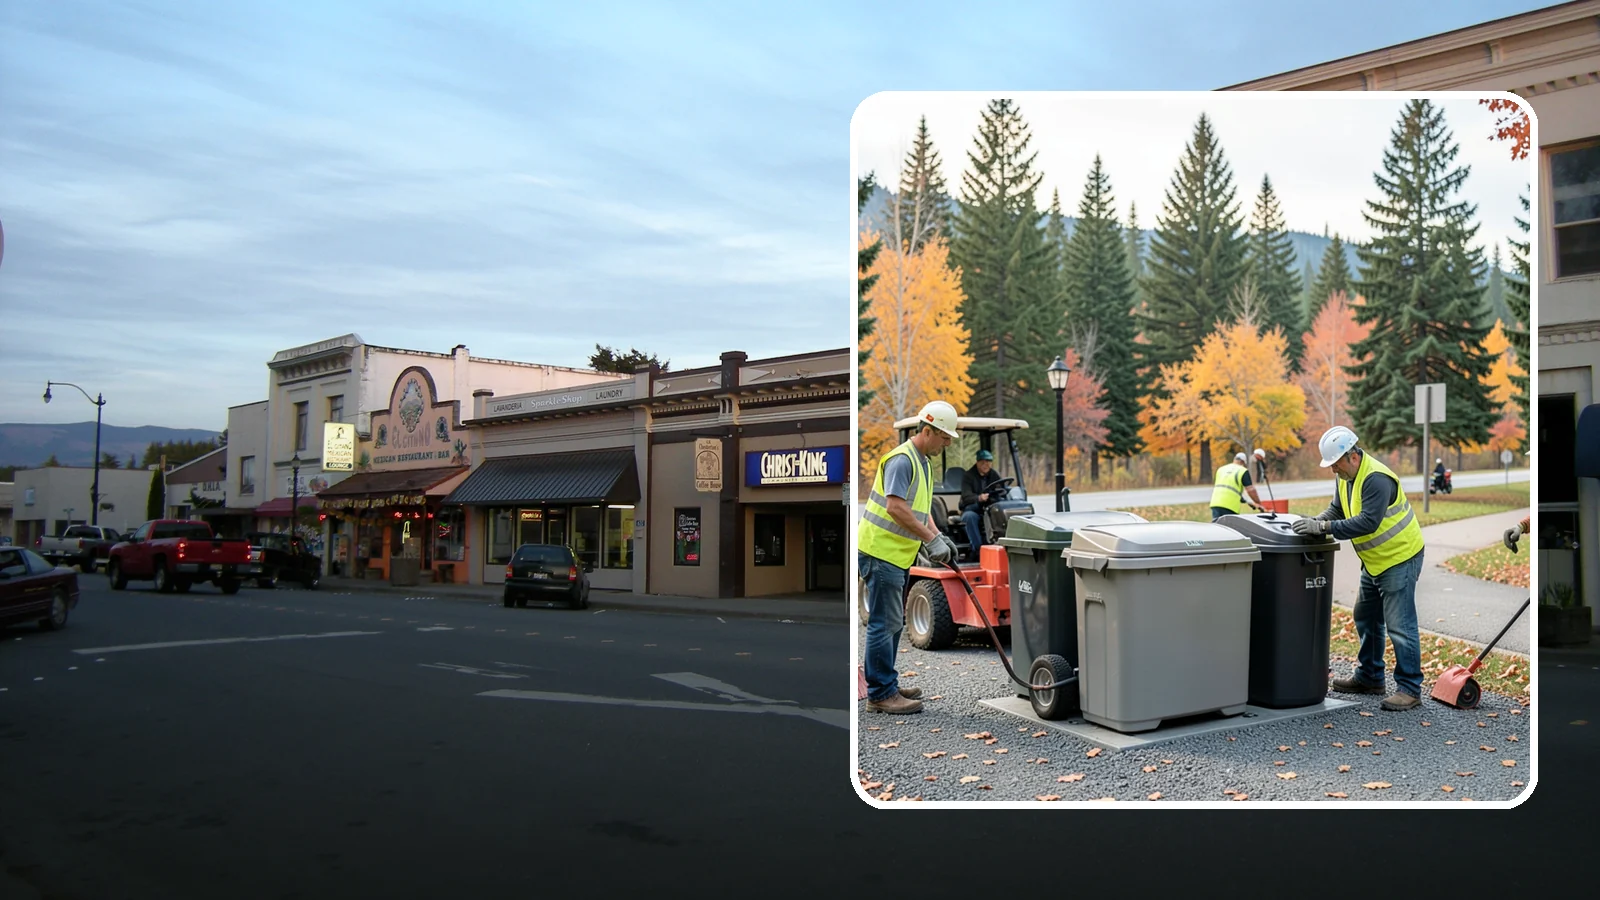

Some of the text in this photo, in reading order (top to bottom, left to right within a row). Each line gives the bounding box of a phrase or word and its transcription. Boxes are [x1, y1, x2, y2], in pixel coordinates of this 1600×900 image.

[494, 388, 623, 412] LAVANDERIA Sparkle Shop LAUNDRY
[374, 450, 449, 463] MEXICAN RESTAURANT BAR
[761, 449, 827, 478] CHRIST KING
[710, 481, 721, 489] House
